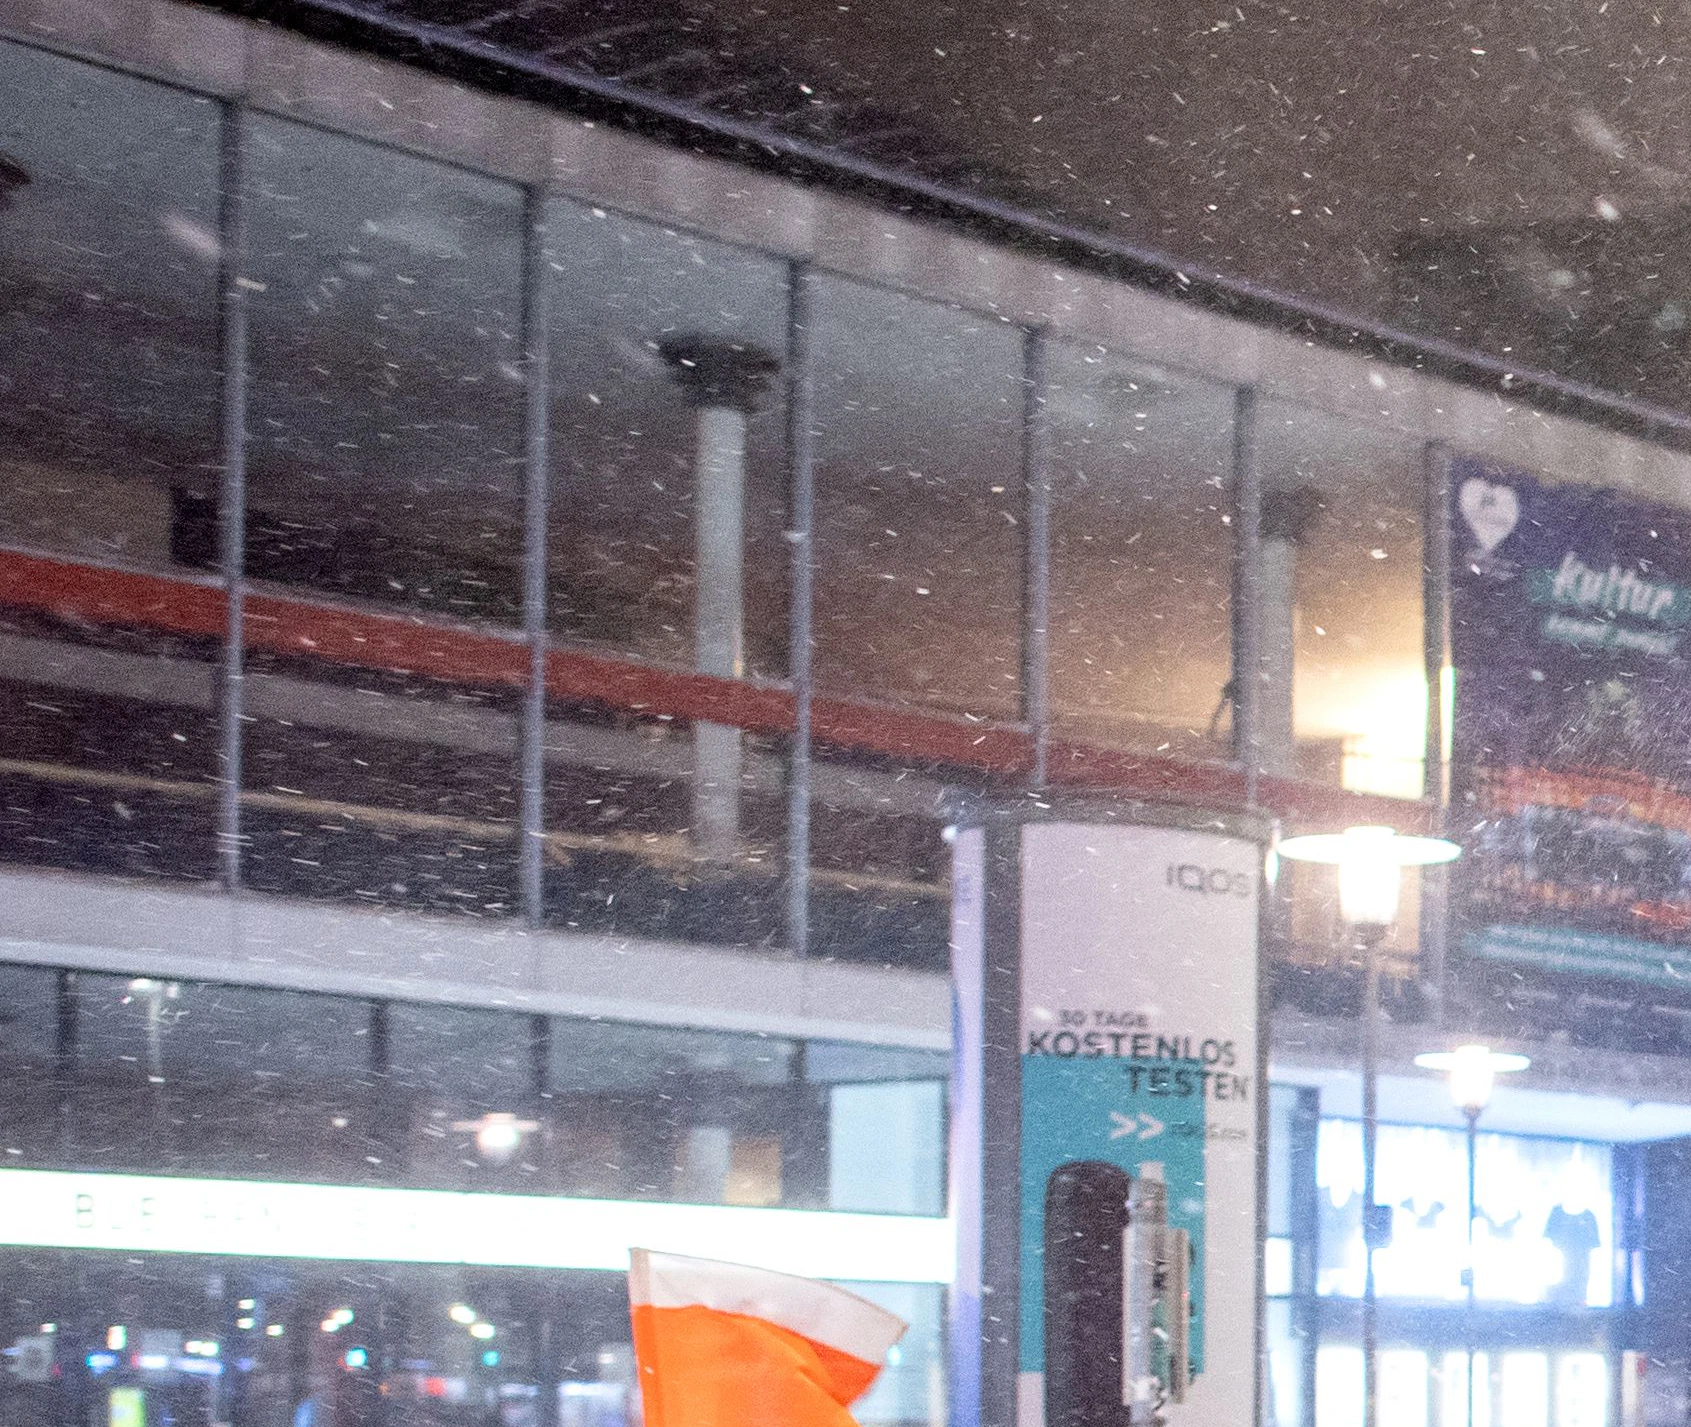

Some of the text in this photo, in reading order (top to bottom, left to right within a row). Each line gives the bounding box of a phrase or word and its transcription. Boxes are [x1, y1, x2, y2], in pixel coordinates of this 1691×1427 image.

[1166, 863, 1252, 897] IQOS
[1093, 1010, 1149, 1028] TAGE
[1028, 1030, 1236, 1067] KOSTENLOS
[1125, 1064, 1250, 1101] TESTEN
